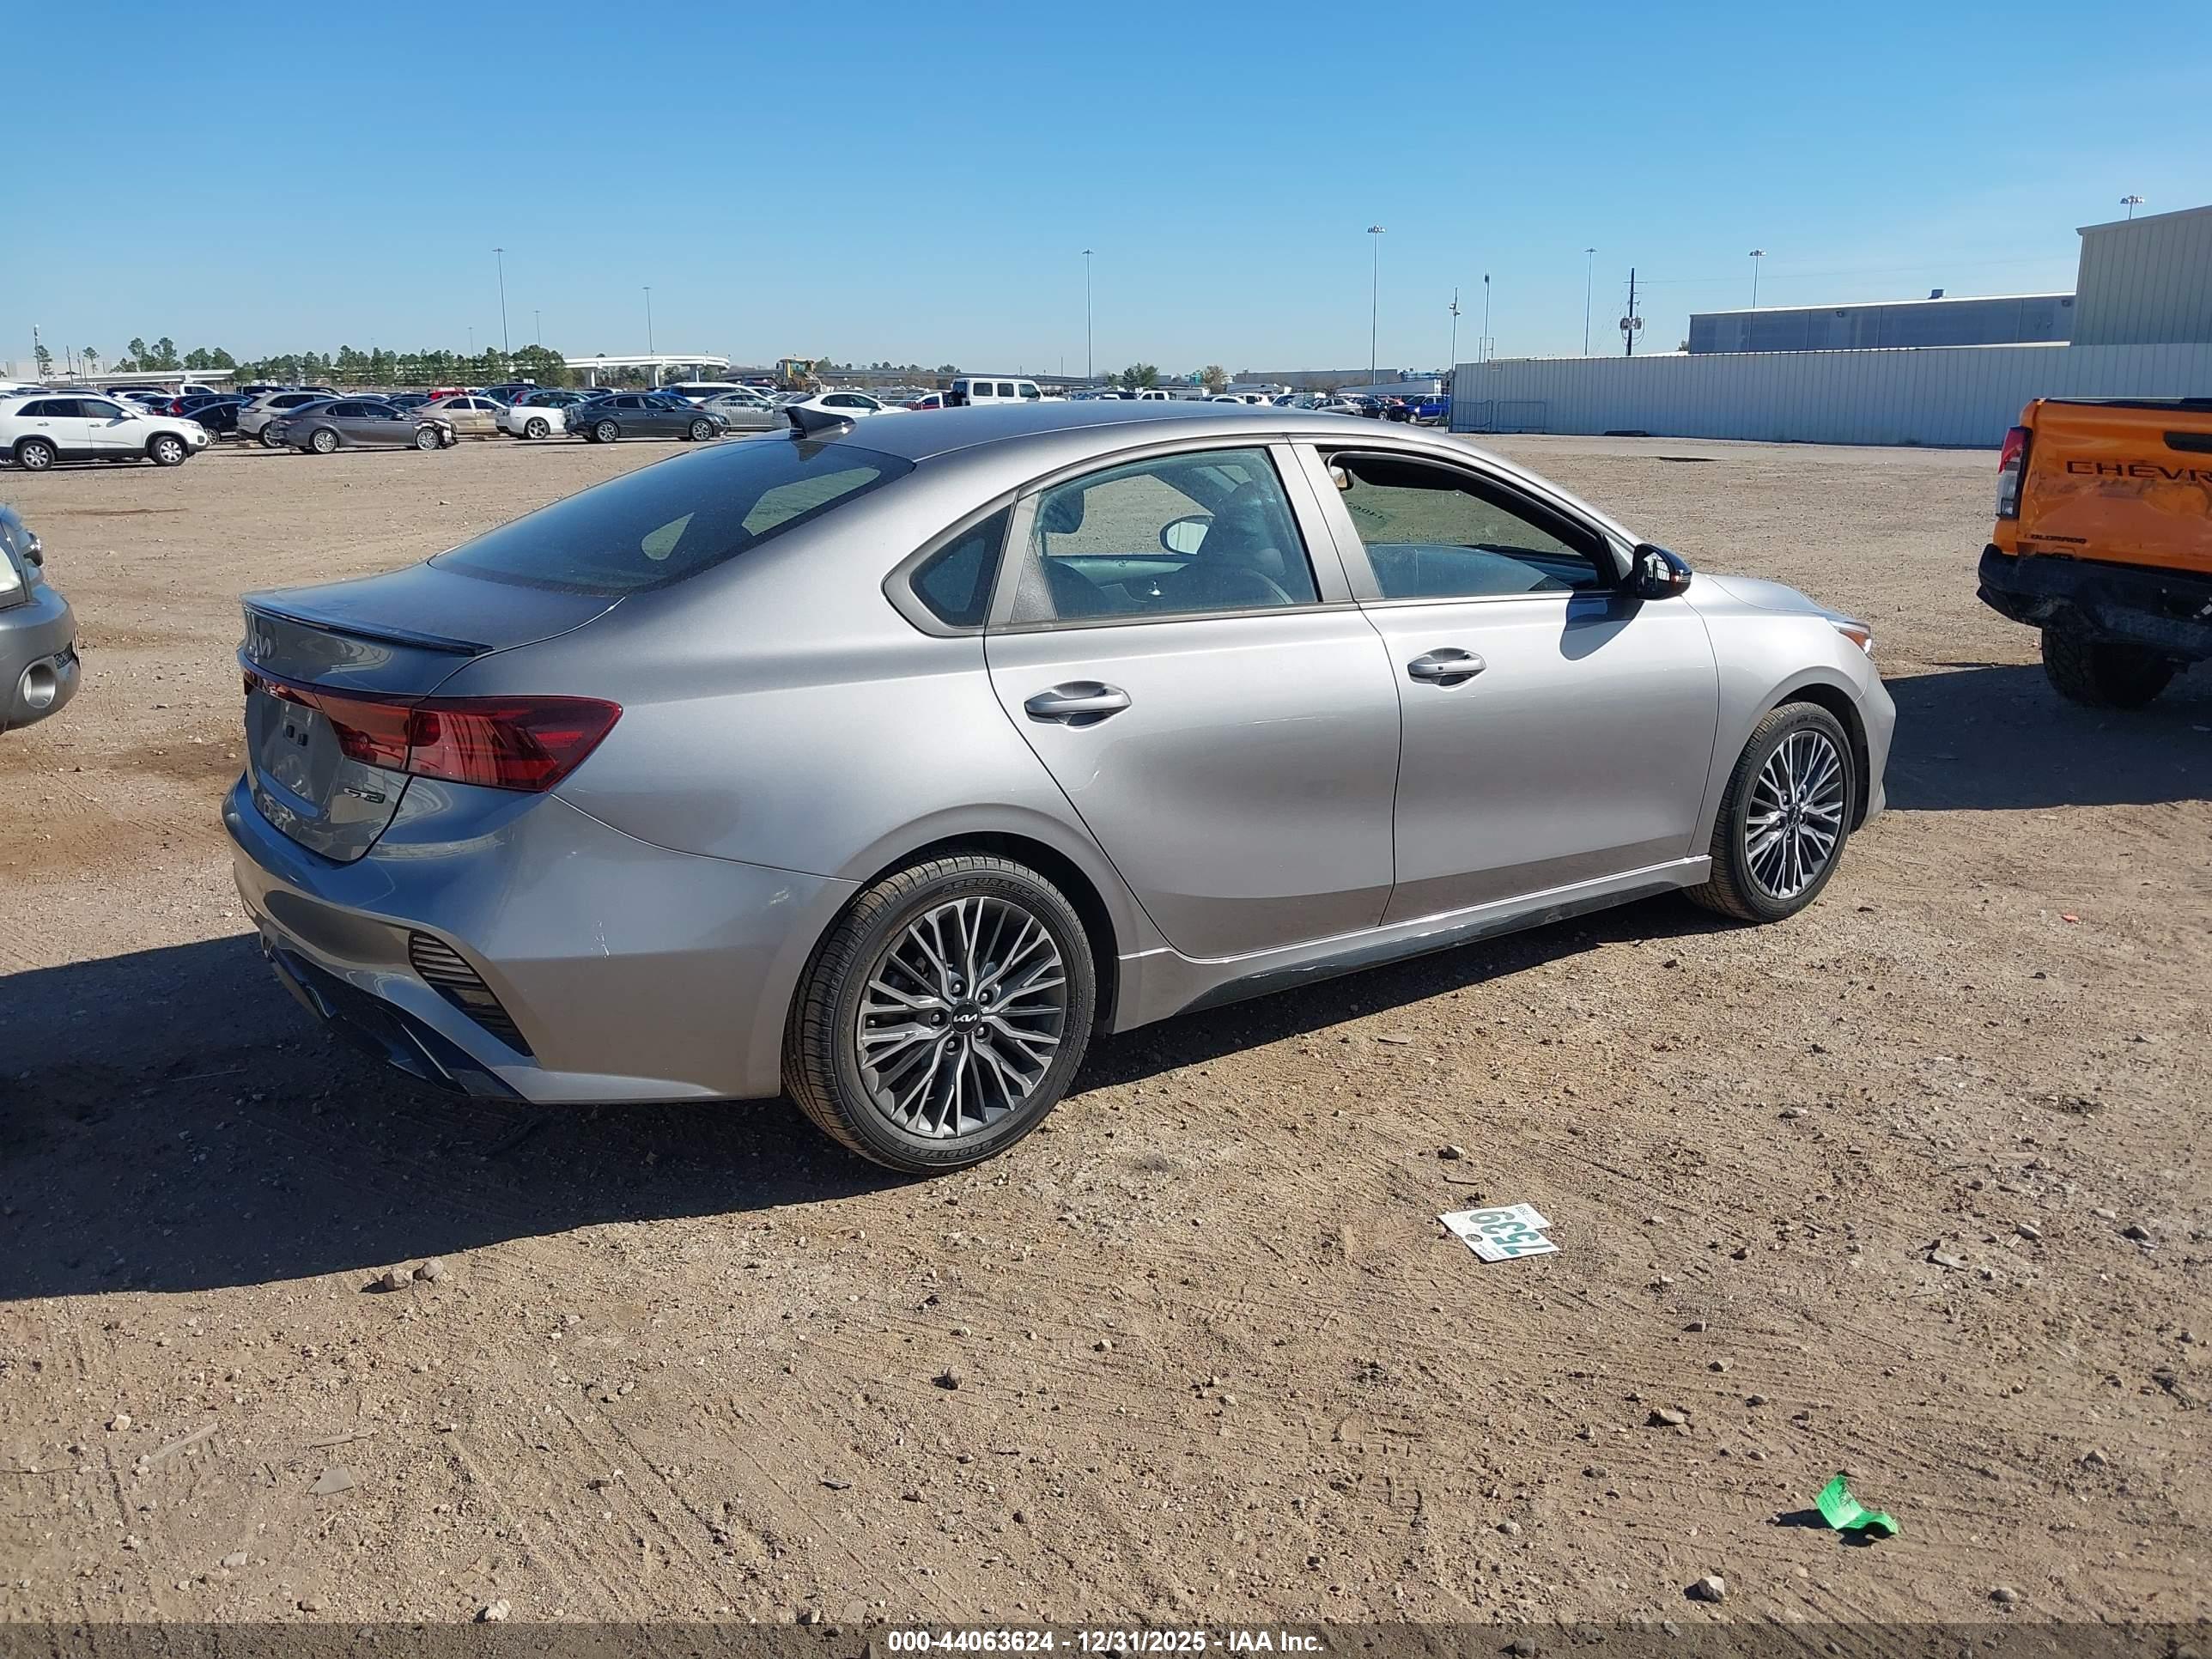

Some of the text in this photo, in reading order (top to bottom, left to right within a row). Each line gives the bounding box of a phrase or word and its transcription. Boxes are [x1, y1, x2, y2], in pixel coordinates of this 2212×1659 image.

[2066, 460, 2212, 483] CHEVR
[895, 1139, 994, 1158] GOODYEAR
[1468, 1211, 1553, 1255] 7539
